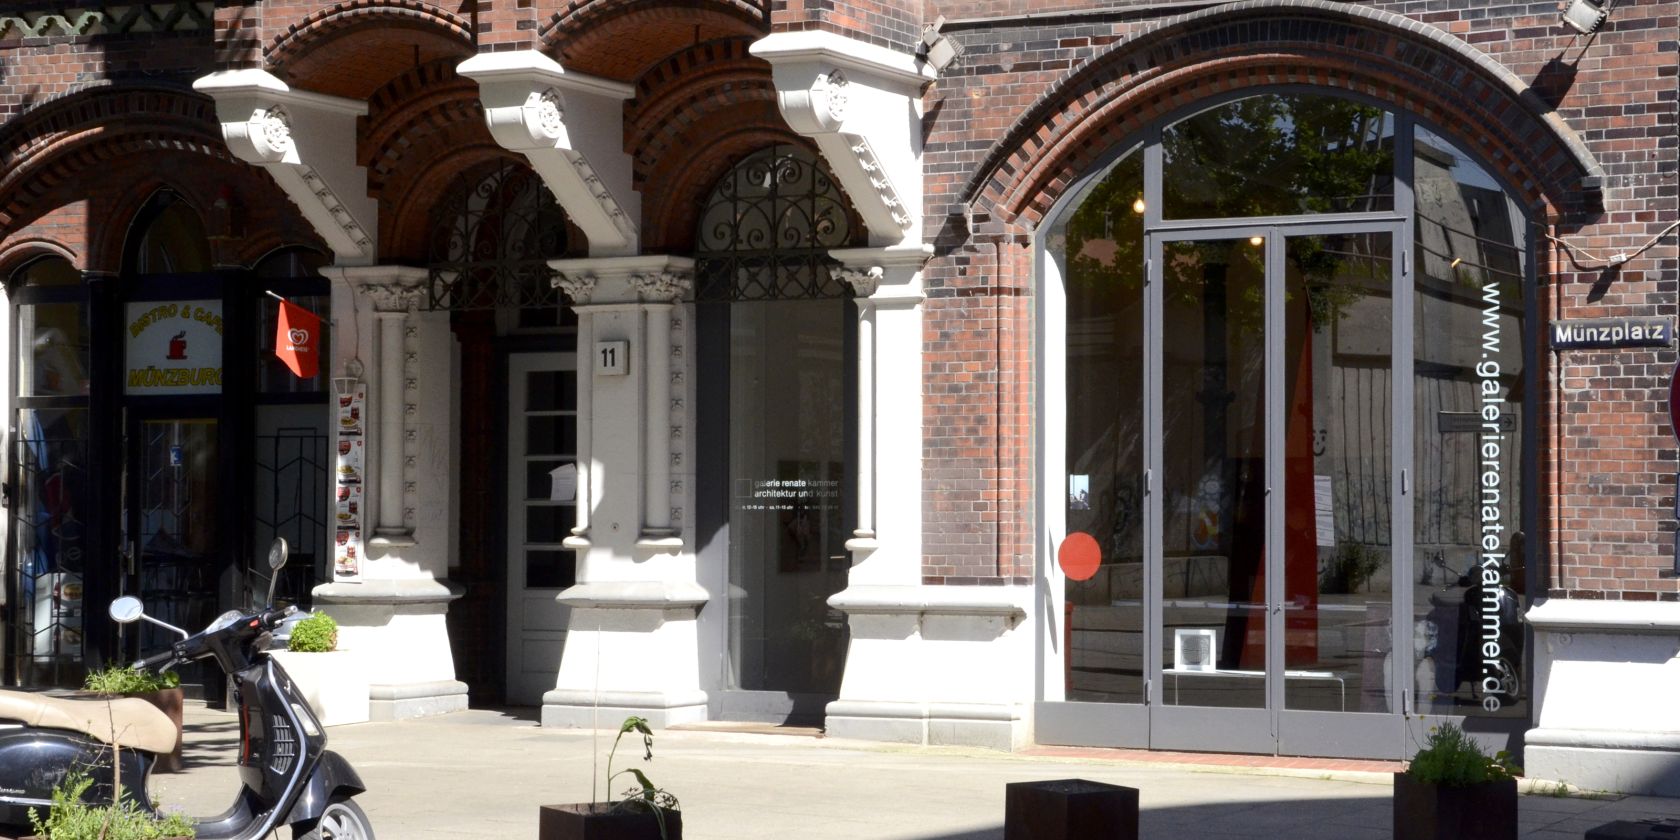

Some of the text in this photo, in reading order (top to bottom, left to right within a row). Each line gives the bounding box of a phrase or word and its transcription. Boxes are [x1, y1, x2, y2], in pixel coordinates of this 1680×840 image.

[129, 304, 178, 338] BISTRO
[181, 304, 191, 319] &
[1555, 322, 1664, 345] Münzplatz
[601, 347, 616, 367] 11
[754, 479, 838, 488] galerie renate kammer
[754, 490, 838, 498] architektur und kunst
[1476, 281, 1506, 712] www.galerierenatekammer.de
